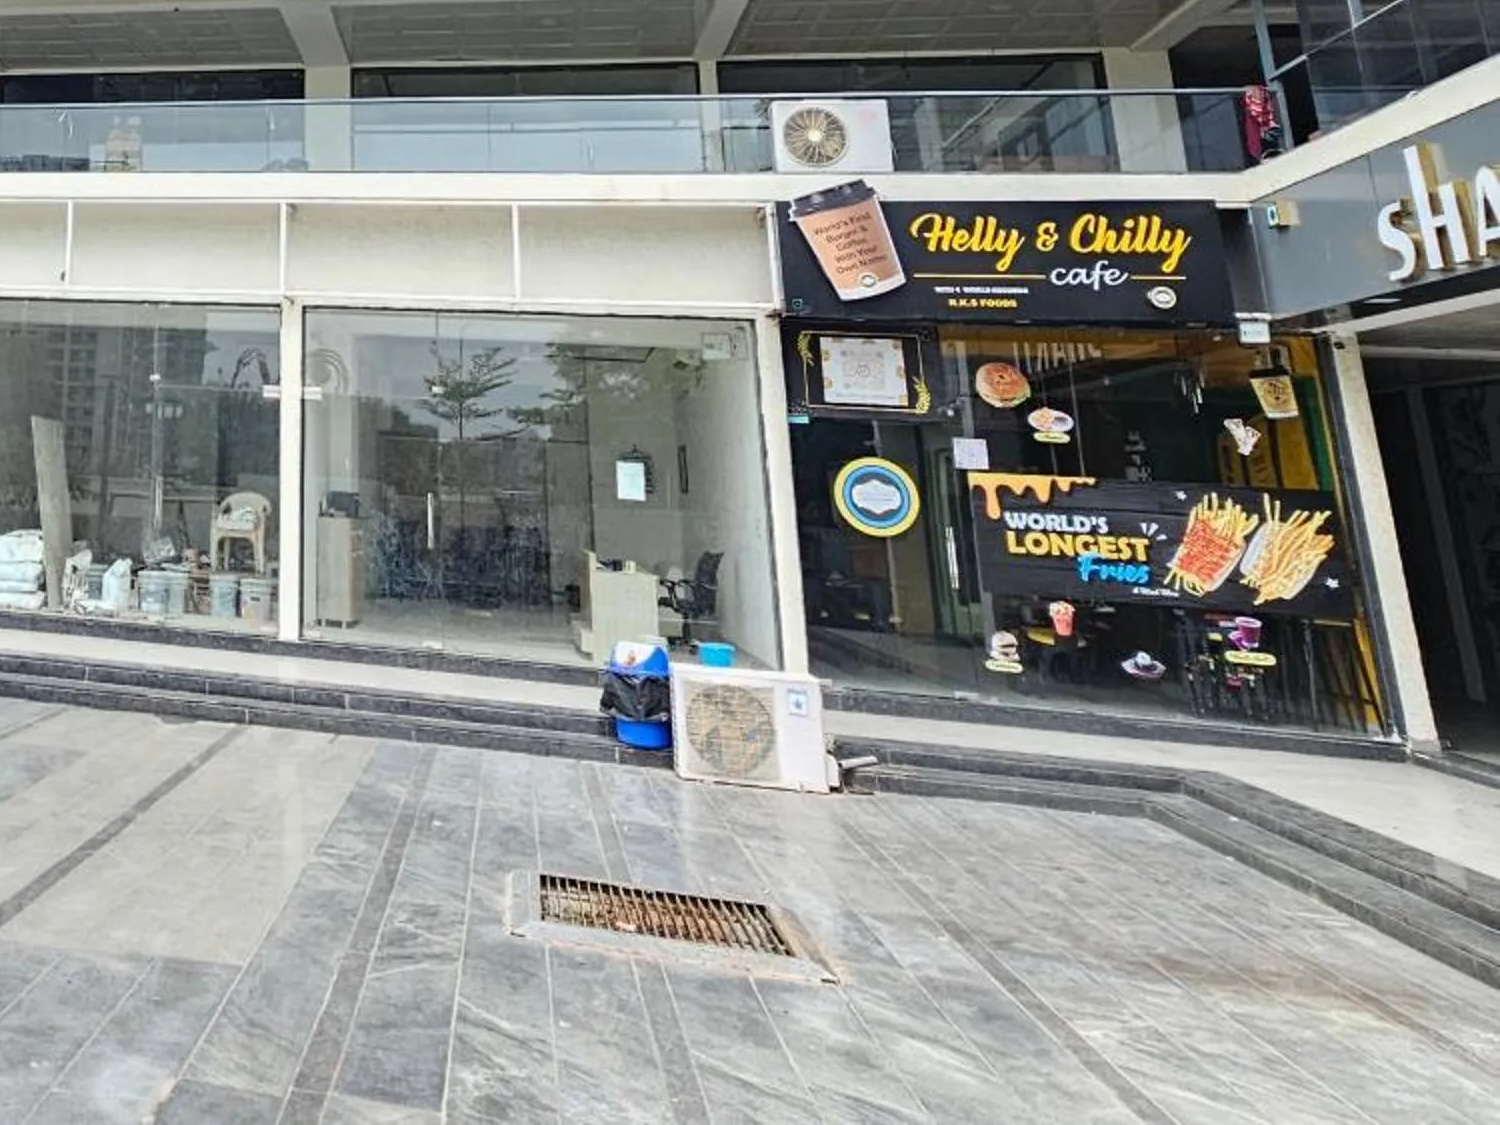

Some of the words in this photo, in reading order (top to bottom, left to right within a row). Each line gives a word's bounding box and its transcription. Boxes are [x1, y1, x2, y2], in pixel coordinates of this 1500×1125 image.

[909, 211, 1026, 272] Helly
[1035, 220, 1059, 252] &
[1068, 212, 1193, 274] Chilly
[1050, 259, 1130, 291] cafe
[1003, 510, 1110, 535] WORLD'S
[1005, 530, 1150, 562] LONGEST
[1077, 550, 1151, 585] Fries
